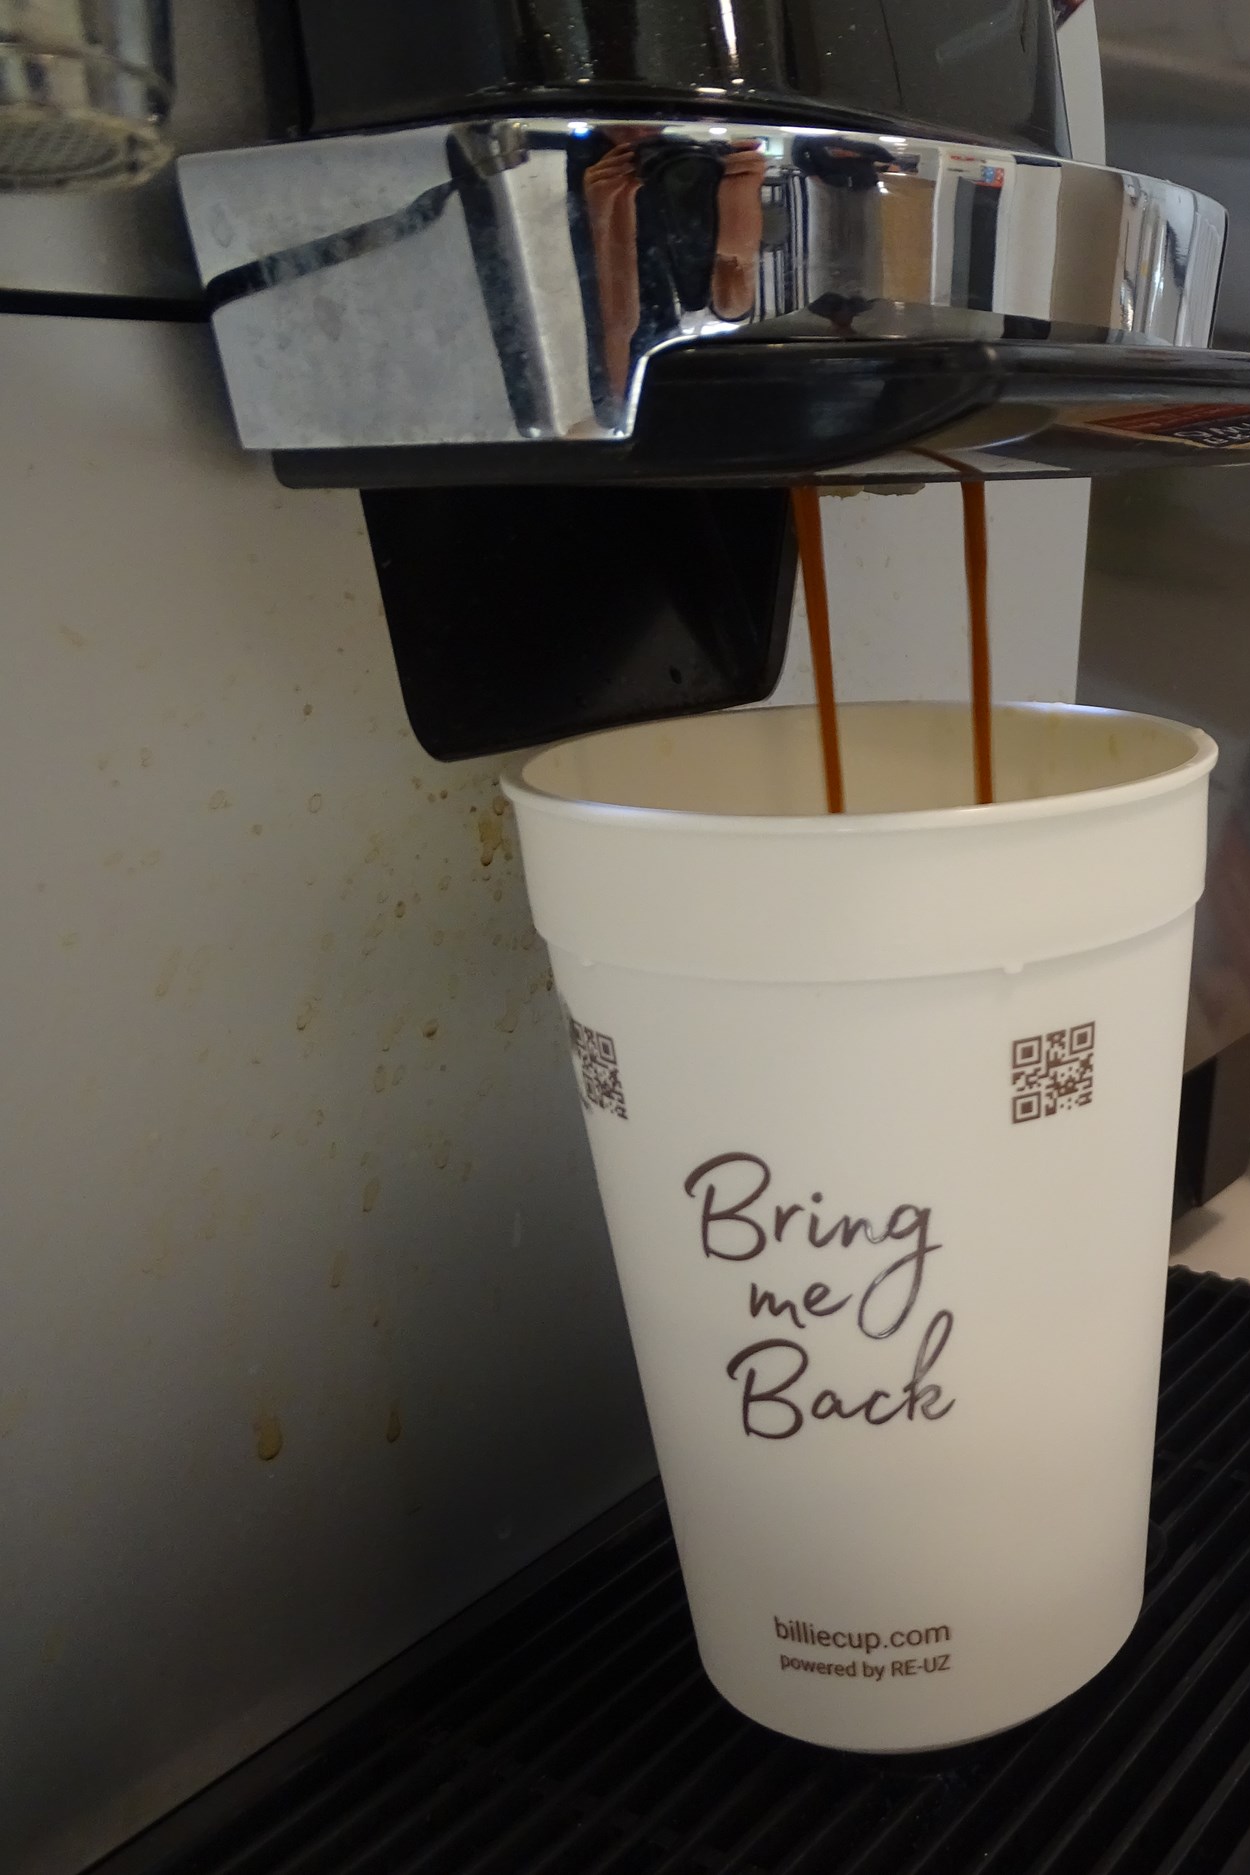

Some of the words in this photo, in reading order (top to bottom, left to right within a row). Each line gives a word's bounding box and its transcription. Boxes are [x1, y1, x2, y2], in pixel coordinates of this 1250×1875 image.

[684, 1151, 943, 1339] Bring
[748, 1281, 854, 1329] me
[726, 1309, 957, 1440] Back
[773, 1615, 951, 1654] billiecup.com
[780, 1654, 856, 1677] powered
[862, 1661, 884, 1681] by
[891, 1654, 951, 1677] RE-UZ
